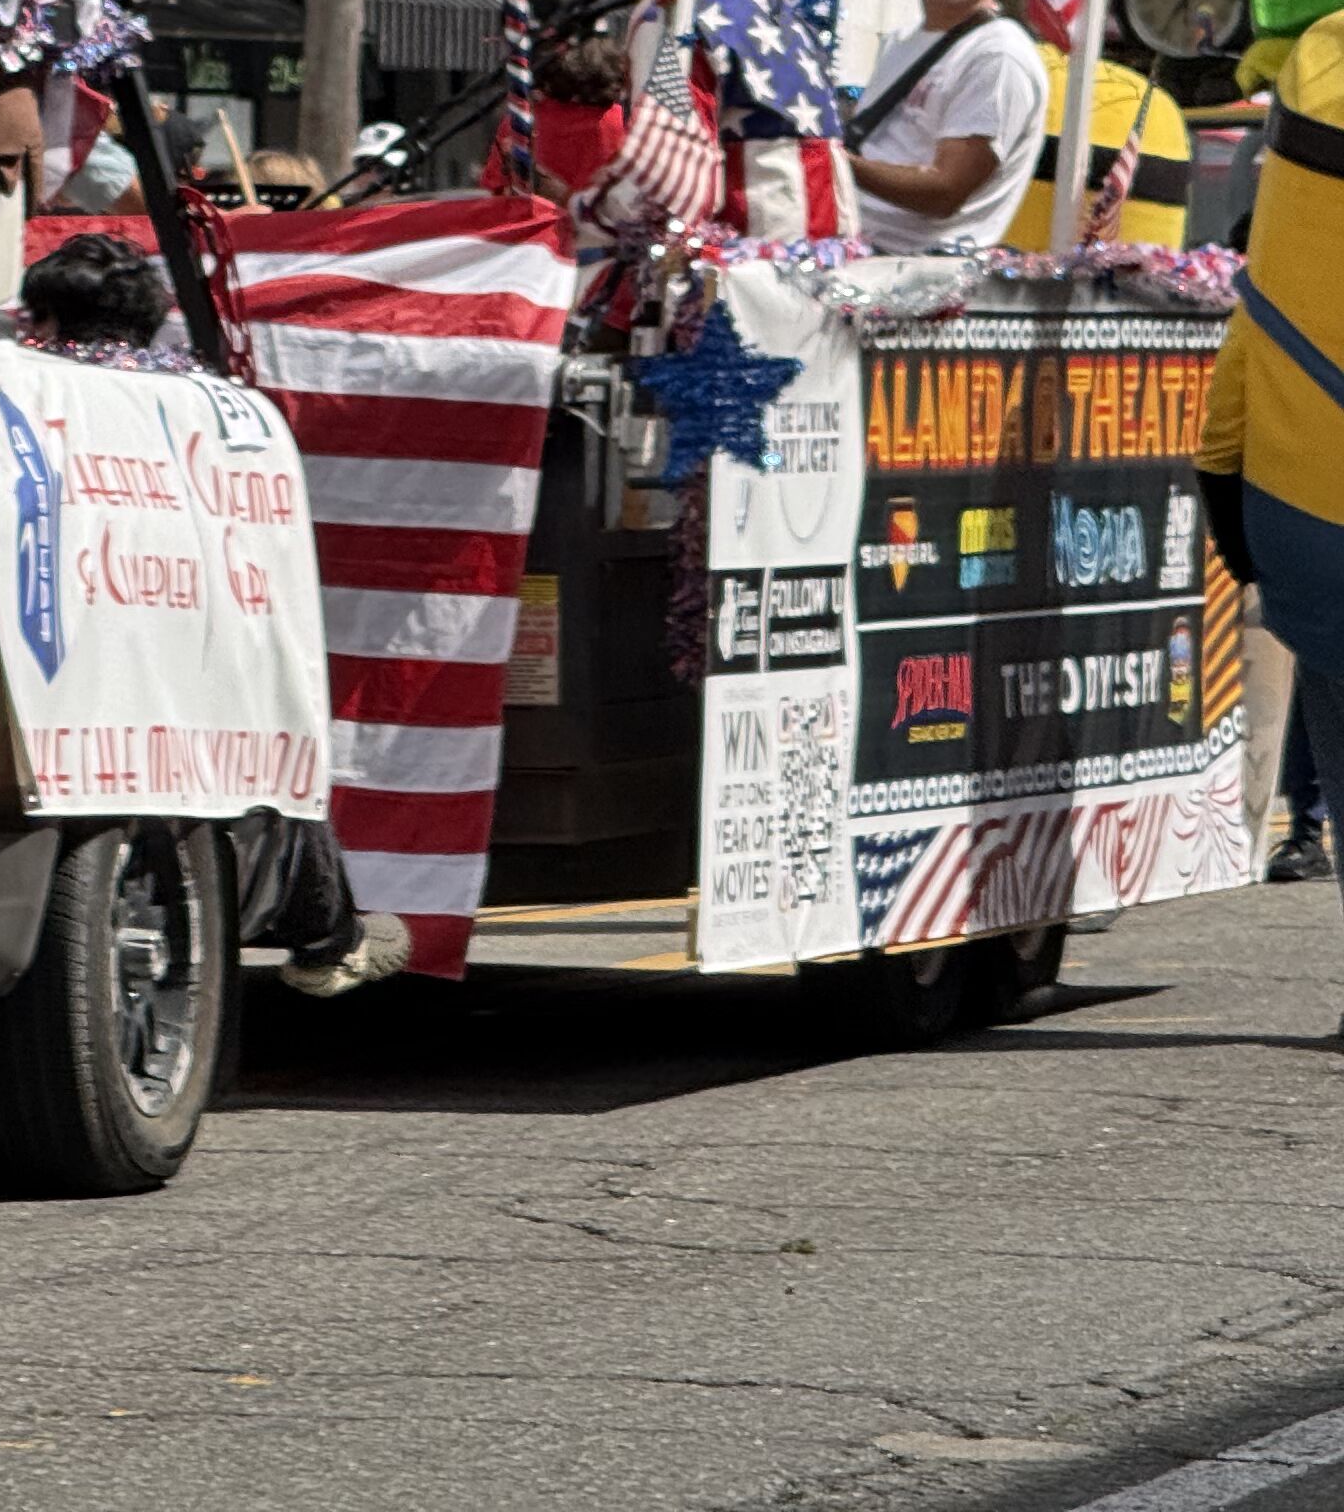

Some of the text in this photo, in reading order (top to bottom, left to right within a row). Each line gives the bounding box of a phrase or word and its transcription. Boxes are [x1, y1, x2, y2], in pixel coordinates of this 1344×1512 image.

[1000, 660, 1056, 719] THE
[721, 709, 769, 775] WIN
[711, 859, 772, 905] MOVIES
